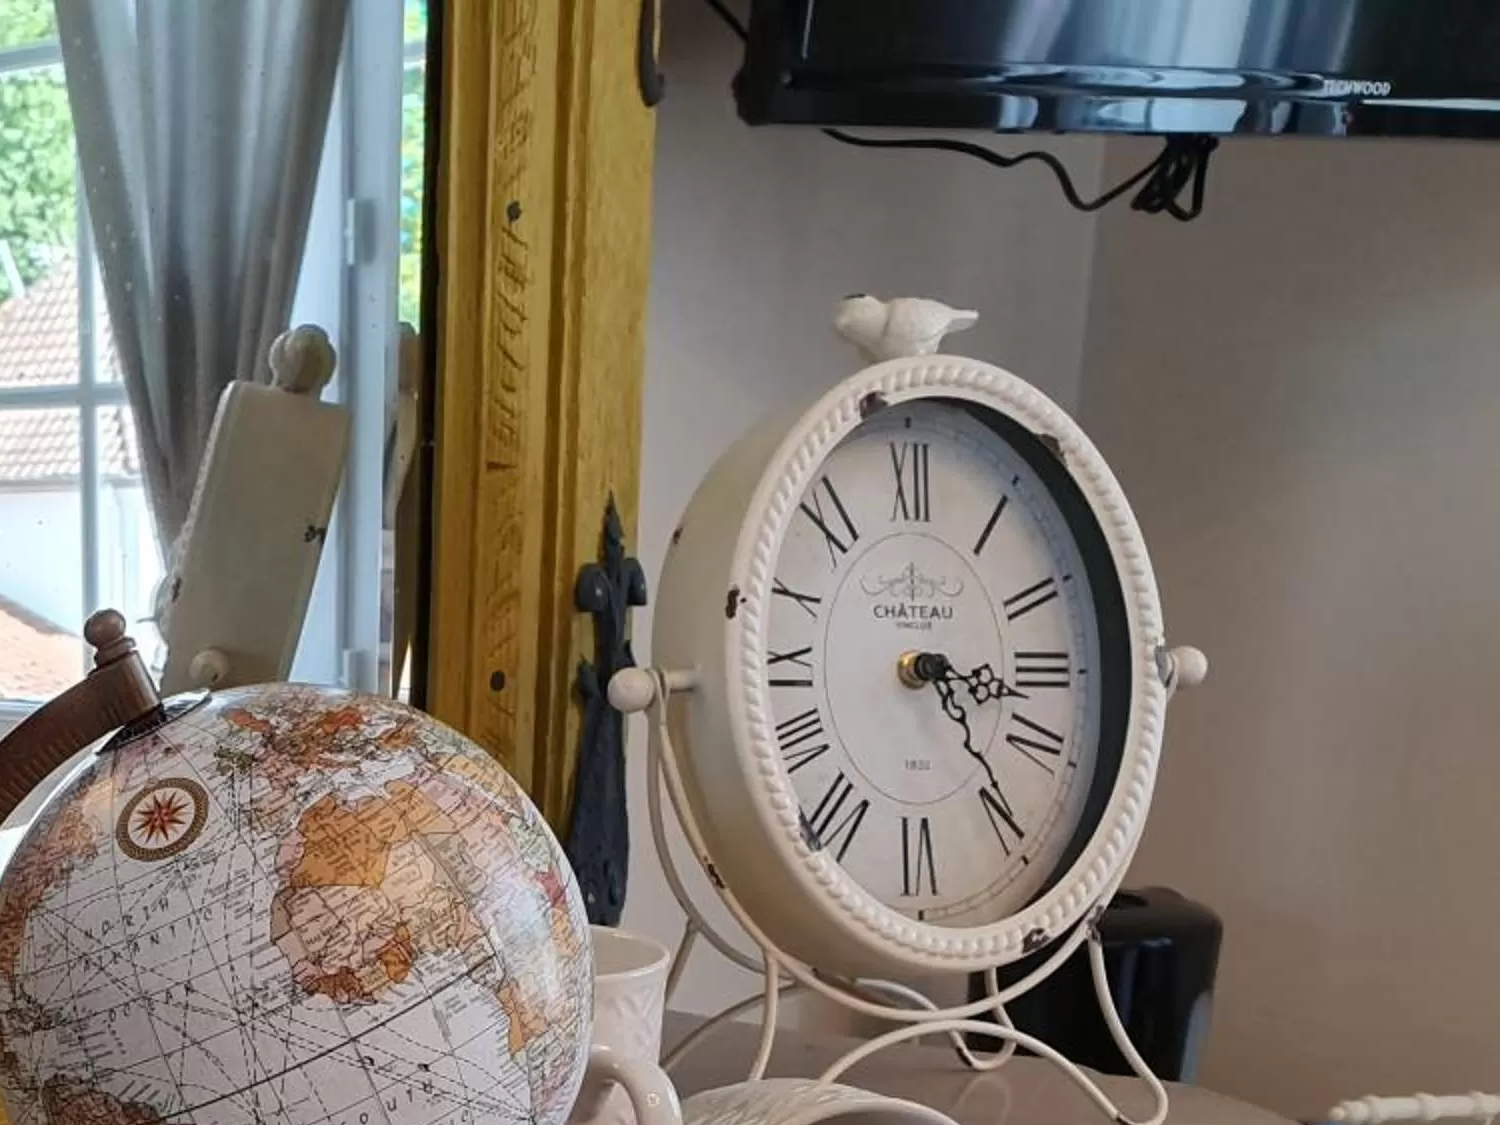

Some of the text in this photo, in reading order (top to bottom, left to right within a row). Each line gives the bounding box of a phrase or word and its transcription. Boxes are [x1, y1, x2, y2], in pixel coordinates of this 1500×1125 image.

[890, 441, 931, 523] XII
[801, 475, 859, 568] XI
[771, 577, 822, 616] X
[766, 646, 813, 687] IX
[1014, 652, 1070, 688] III
[900, 816, 938, 897] VI
